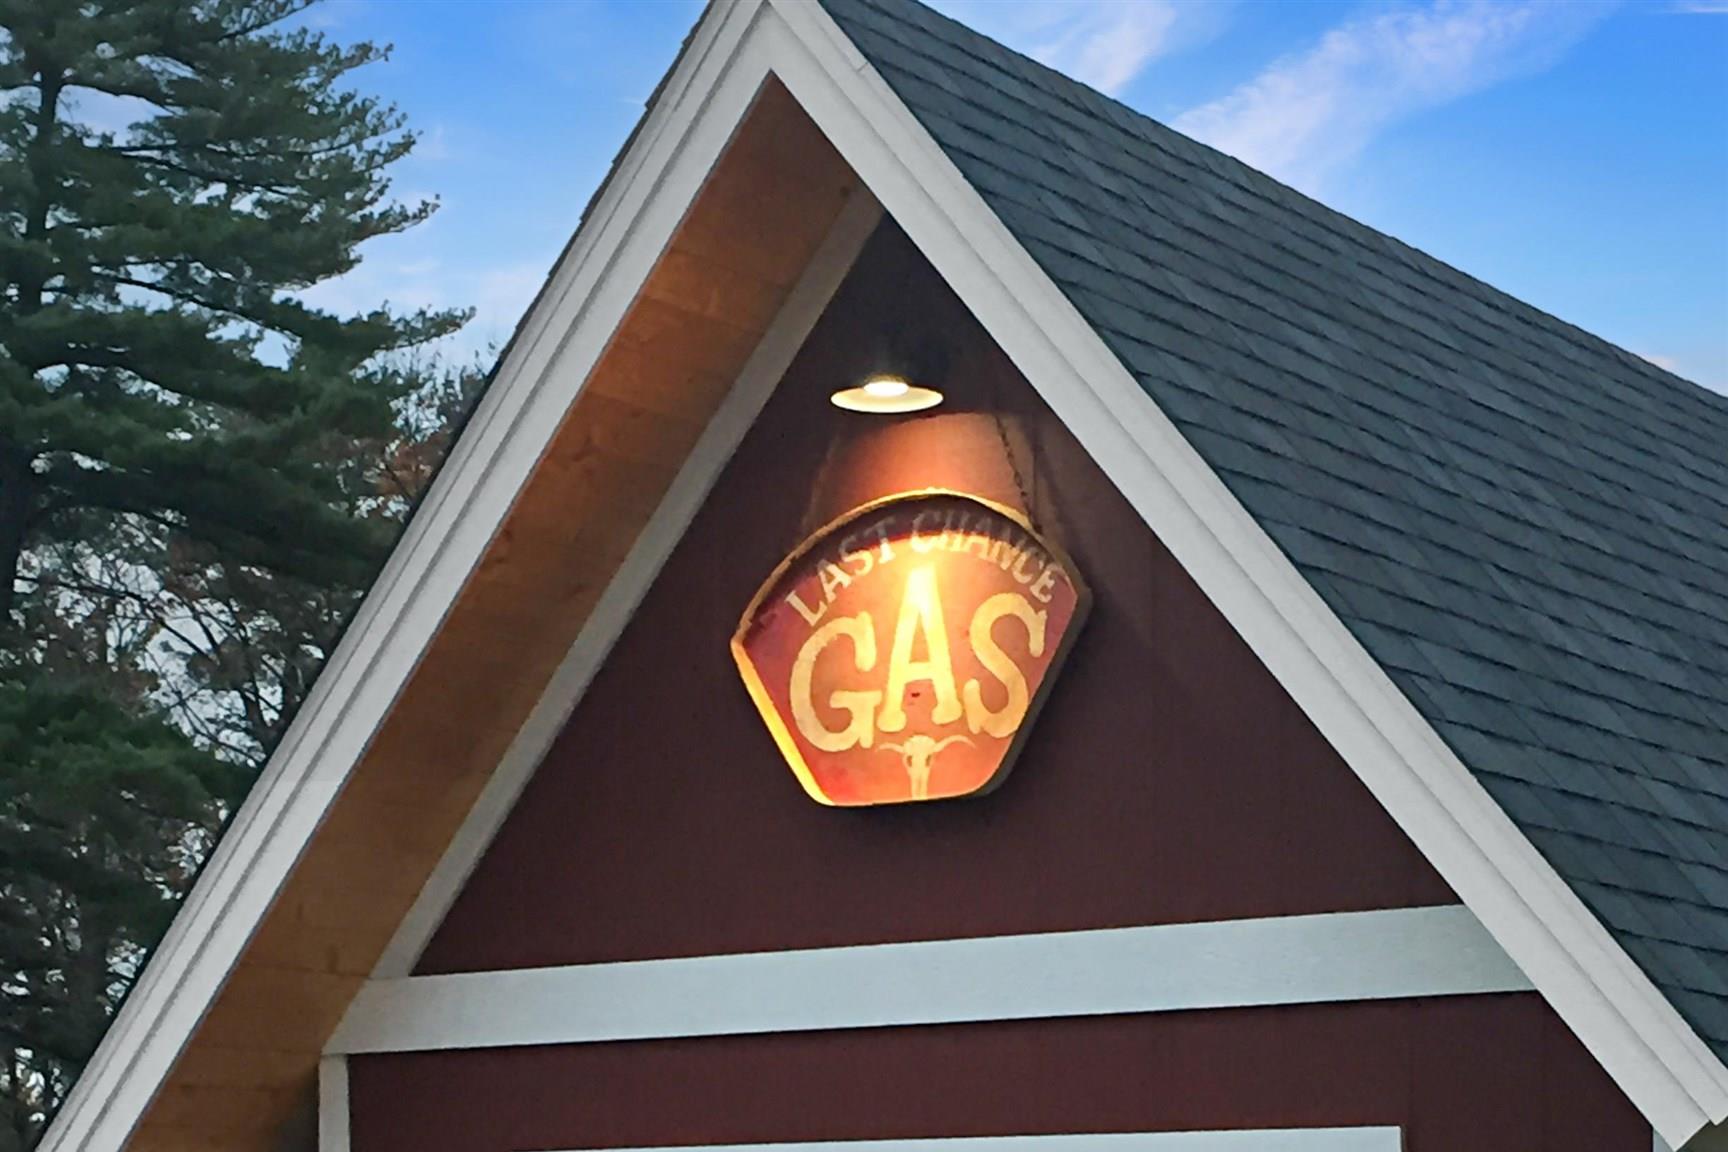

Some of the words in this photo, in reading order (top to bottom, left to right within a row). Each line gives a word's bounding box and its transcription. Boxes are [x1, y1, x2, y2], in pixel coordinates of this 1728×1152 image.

[784, 516, 898, 627] LAST
[910, 509, 1068, 604] CHANCE
[789, 565, 1047, 752] GAS
